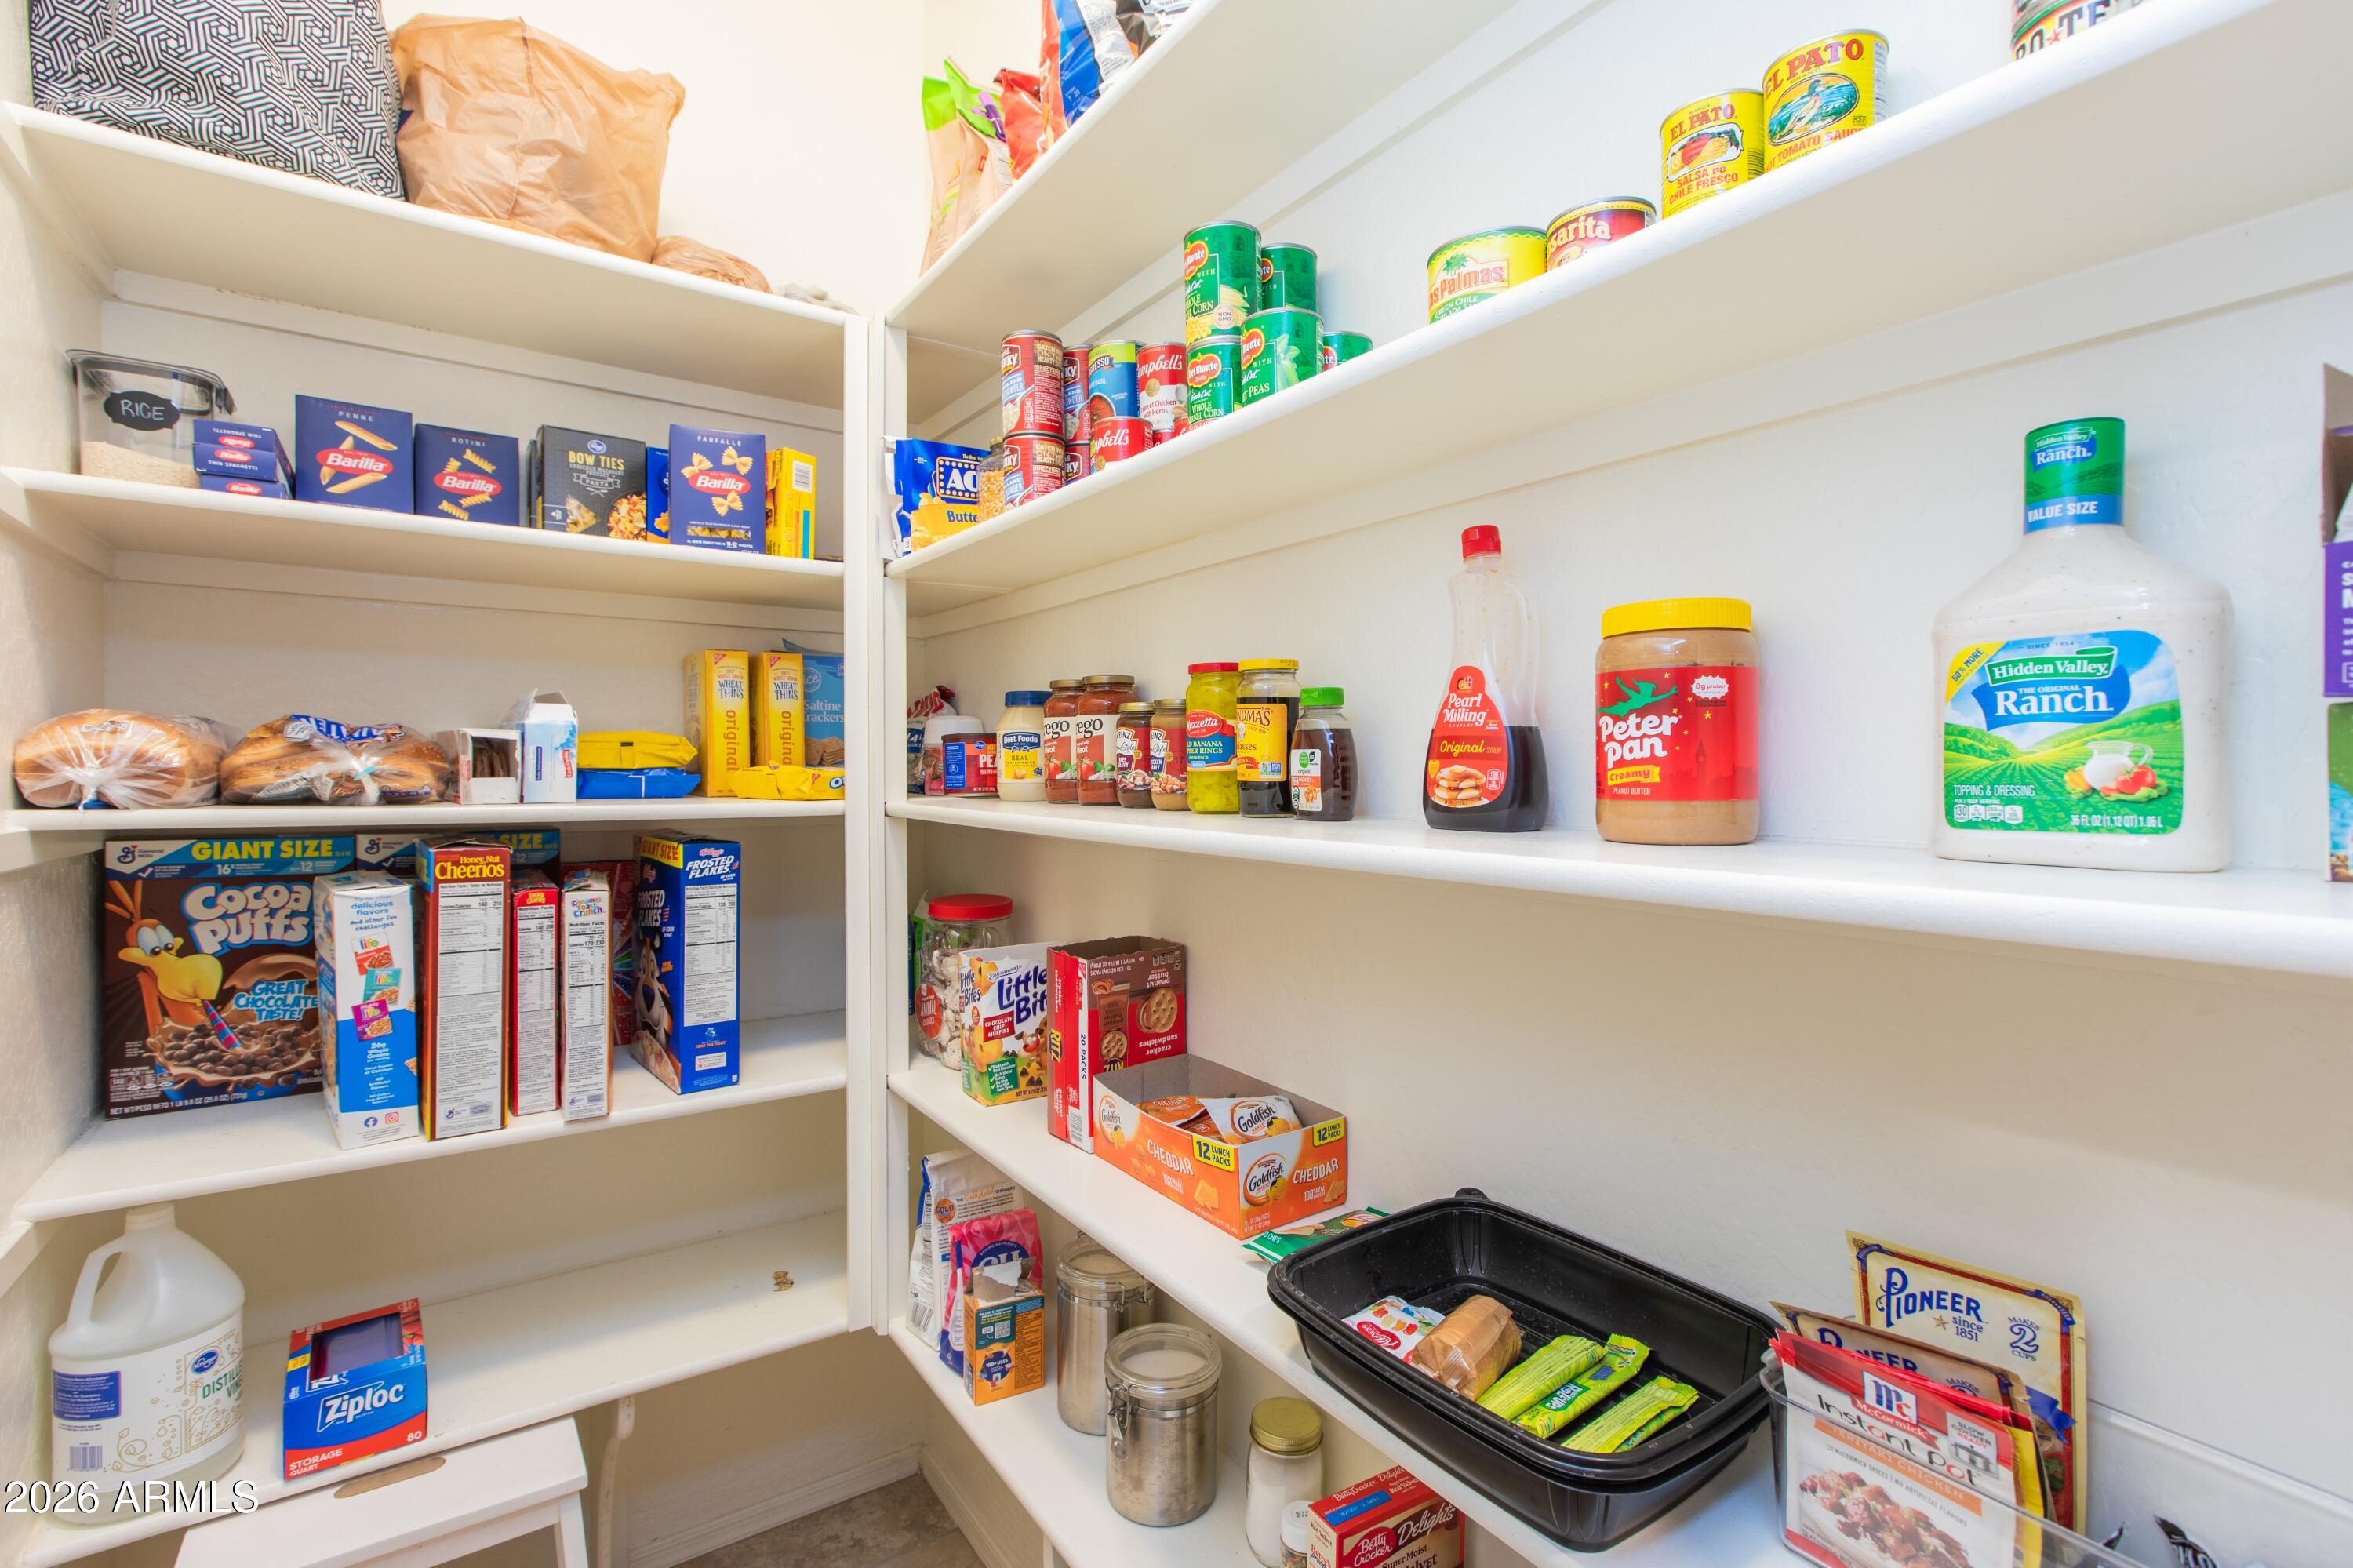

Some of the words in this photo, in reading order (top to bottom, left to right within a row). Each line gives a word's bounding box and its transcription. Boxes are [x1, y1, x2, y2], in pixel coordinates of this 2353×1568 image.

[1787, 39, 1864, 81] PATO
[1671, 120, 1687, 141] EL
[1688, 104, 1736, 132] PATO
[1777, 134, 1821, 160] TOMATO
[1677, 168, 1711, 189] SALSA
[1712, 166, 1726, 176] de
[1669, 184, 1693, 205] CHILE
[1695, 173, 1739, 191] FRESCO
[1197, 268, 1216, 278] WITH
[1440, 265, 1506, 300] Palmas
[1036, 344, 1054, 353] CATCH
[1037, 356, 1055, 365] HEARTY
[1253, 358, 1273, 368] WITH
[1249, 383, 1271, 398] PEAS
[120, 399, 165, 420] RICE
[1152, 407, 1169, 416] Herbs
[1155, 399, 1176, 408] Chicken
[338, 410, 374, 423] PENNE
[213, 427, 246, 437] SPAGHETTI
[451, 437, 486, 447] ROTINI
[697, 435, 742, 447] FARFALLE
[224, 461, 258, 471] SPAGHETTI
[326, 453, 387, 472] Barilla
[569, 450, 596, 465] BOW
[599, 455, 624, 471] TIES
[442, 476, 496, 493] Barilla
[696, 475, 745, 491] Barilla
[2027, 504, 2063, 522] VALUE
[2066, 500, 2099, 516] SIZE
[1964, 647, 1985, 667] MORE
[1991, 663, 2054, 680] Hidden
[718, 680, 744, 689] WHEAT
[773, 682, 798, 691] WHEAT
[1695, 682, 1706, 691] 8g
[2037, 685, 2082, 693] ORIGINAL
[718, 689, 744, 700] THINS
[775, 690, 798, 700] THINS
[1448, 693, 1482, 708] Pearl
[1443, 709, 1487, 727] Milling
[1598, 712, 1680, 742] Peter
[1003, 735, 1017, 744] Best
[1018, 735, 1039, 744] Foods
[1440, 740, 1486, 757] Original
[1604, 737, 1668, 769] Pan
[1609, 768, 1651, 782] Creamy
[1631, 787, 1651, 795] BUTTER
[1953, 785, 1984, 796] TOPPING
[1986, 785, 1992, 796] &
[1994, 785, 2036, 797] DRESSING
[191, 841, 274, 860] GIANT
[279, 840, 333, 857] SIZE
[641, 839, 659, 856] GIANT
[660, 842, 679, 861] SIZE
[460, 855, 484, 864] Honey
[486, 855, 500, 864] Nut
[685, 855, 734, 871] FROSTED
[435, 862, 505, 879] Cheerios
[688, 864, 730, 880] FLAKES
[185, 885, 311, 921] Cocoa
[351, 900, 394, 910] delicious
[356, 907, 389, 916] flavors
[573, 908, 603, 919] Crunch
[638, 908, 662, 927] FLAKES
[365, 916, 384, 925] other
[960, 969, 975, 994] Little
[1147, 971, 1169, 980] butter
[1147, 978, 1171, 988] peanut
[250, 980, 309, 996] GREAT
[998, 965, 1047, 1010] Little
[964, 988, 980, 1006] Bites
[255, 1008, 304, 1022] TASTE!
[984, 1015, 1013, 1028] CHOCOLATE
[987, 1028, 1010, 1038] MUFFINS
[1080, 1033, 1086, 1046] 20
[1138, 1034, 1178, 1048] sandwiches
[1051, 1029, 1062, 1064] RITZ
[1146, 1044, 1172, 1056] cracker
[1101, 1108, 1122, 1125] Goldfish
[1238, 1103, 1277, 1133] Goldfish
[1317, 1127, 1328, 1142] 12
[1327, 1122, 1341, 1133] LUNCH
[1327, 1129, 1342, 1138] PACKS
[1147, 1139, 1195, 1176] CHEDDAR
[1195, 1140, 1211, 1161] 12
[1211, 1144, 1231, 1159] LUNCH
[1211, 1154, 1231, 1167] PACKS
[1249, 1162, 1285, 1192] Goldfish
[1292, 1157, 1339, 1184] CHEDDAR
[995, 1185, 1016, 1194] STANDARD
[936, 1204, 954, 1215] GOLD
[1267, 1233, 1282, 1245] CHIPS
[1875, 1266, 1984, 1328] PIONEER
[1951, 1315, 1984, 1333] since
[2007, 1316, 2041, 1332] MAKES
[1955, 1326, 1980, 1343] 1851
[2009, 1322, 2039, 1353] 2
[2010, 1350, 2038, 1362] CUPS
[1945, 1377, 1980, 1394] MAKES
[325, 1384, 404, 1424] Ziploc
[1817, 1393, 1917, 1457] Instant
[1856, 1399, 1926, 1440] McCormick
[406, 1431, 423, 1442] 80
[1951, 1423, 1992, 1446] COOKER
[1956, 1421, 1985, 1438] SLOW
[1956, 1431, 1988, 1450] READY
[289, 1448, 344, 1471] STORAGE
[1831, 1427, 1894, 1465] TERIYAKI
[1896, 1458, 1965, 1501] CHICKEN
[290, 1463, 320, 1477] QUART
[1332, 1488, 1354, 1502] Betty
[1351, 1480, 1379, 1495] Crocker
[1378, 1466, 1406, 1483] Delights
[1893, 1479, 1904, 1488] NO
[1398, 1502, 1457, 1546] Delights
[1358, 1530, 1388, 1555] Betty
[1354, 1542, 1394, 1568] Crocker
[1406, 1545, 1430, 1561] Moist
